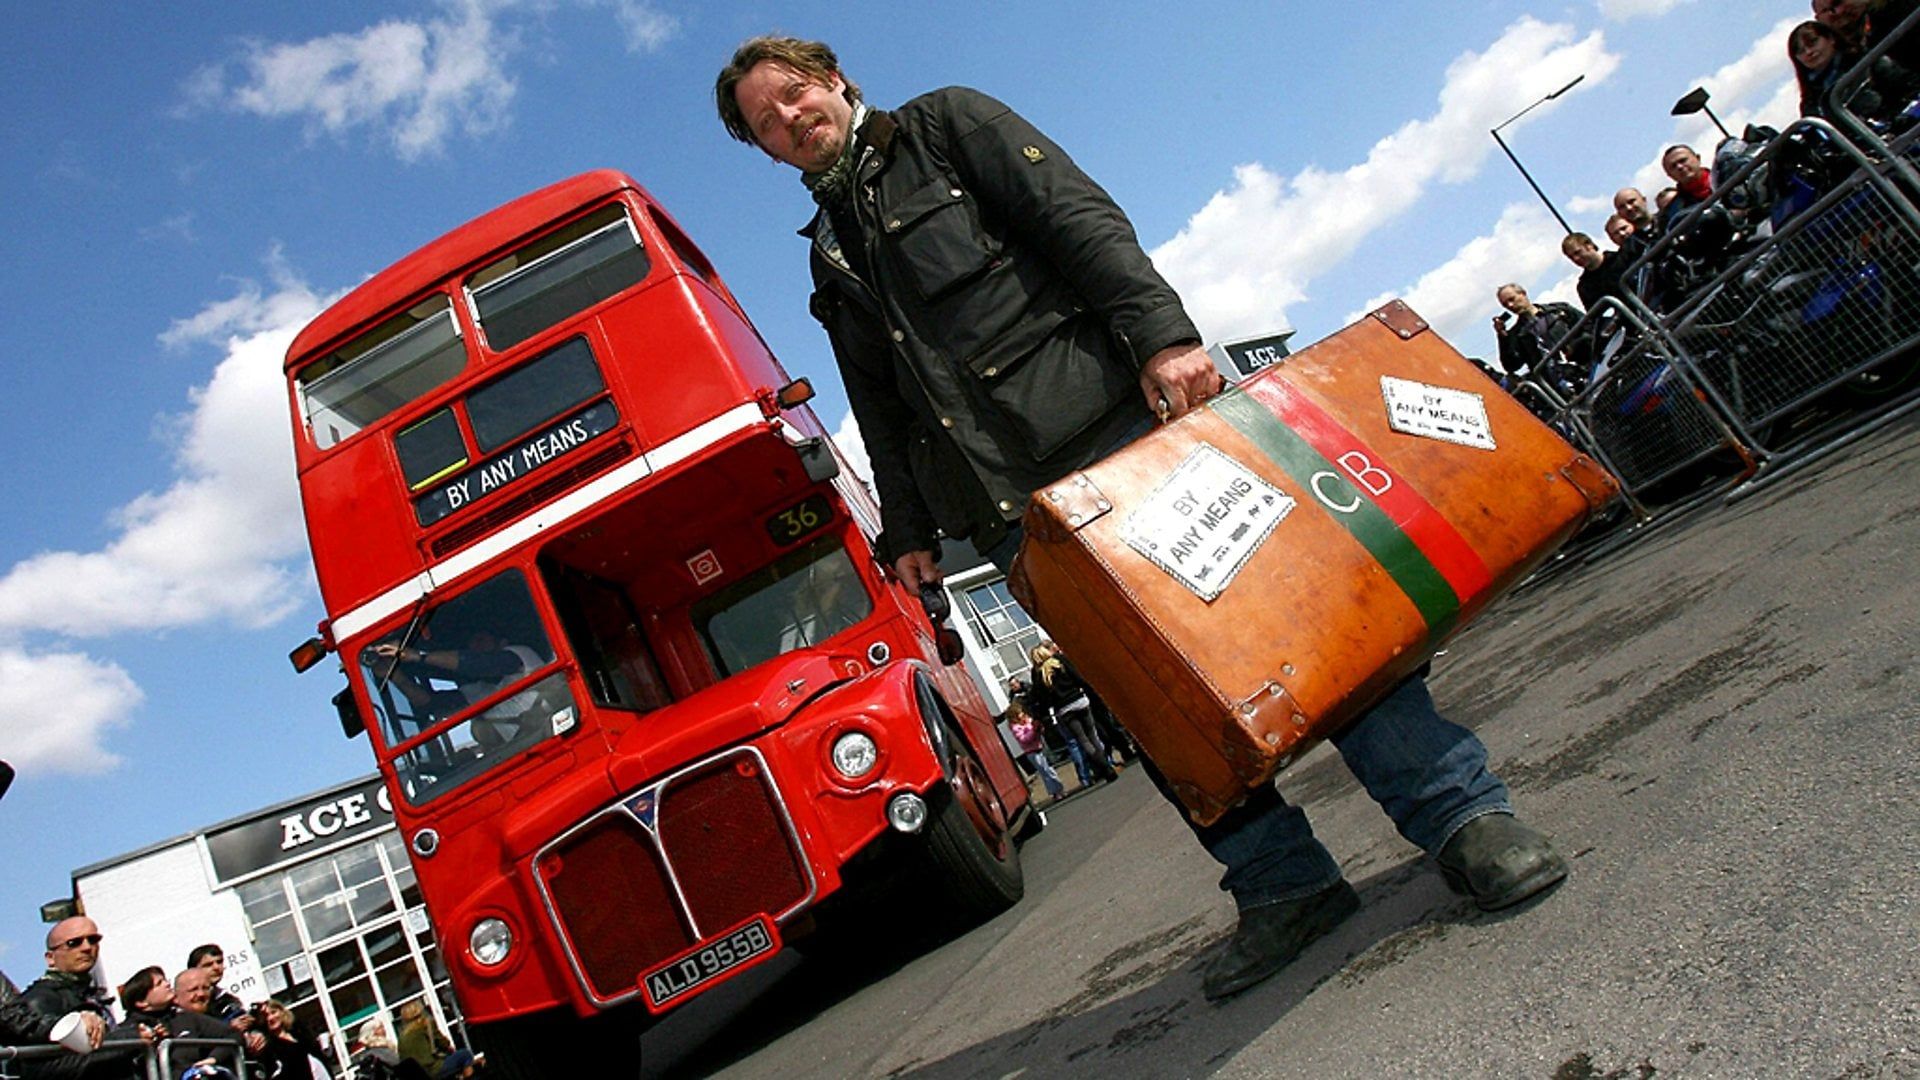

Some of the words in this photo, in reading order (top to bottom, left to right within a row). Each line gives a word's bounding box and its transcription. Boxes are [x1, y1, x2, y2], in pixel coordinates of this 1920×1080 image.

[1245, 346, 1280, 368] ACE
[1396, 402, 1424, 415] ANY
[1428, 409, 1480, 427] MEANS
[446, 479, 470, 509] BY
[480, 455, 516, 493] ANY
[521, 420, 588, 469] MEANS
[1172, 490, 1200, 516] BY
[780, 504, 818, 536] 36
[1169, 526, 1204, 564] ANY
[1198, 477, 1252, 531] MEANS
[280, 793, 371, 850] ACE
[226, 950, 248, 967] RS
[230, 976, 256, 993] om
